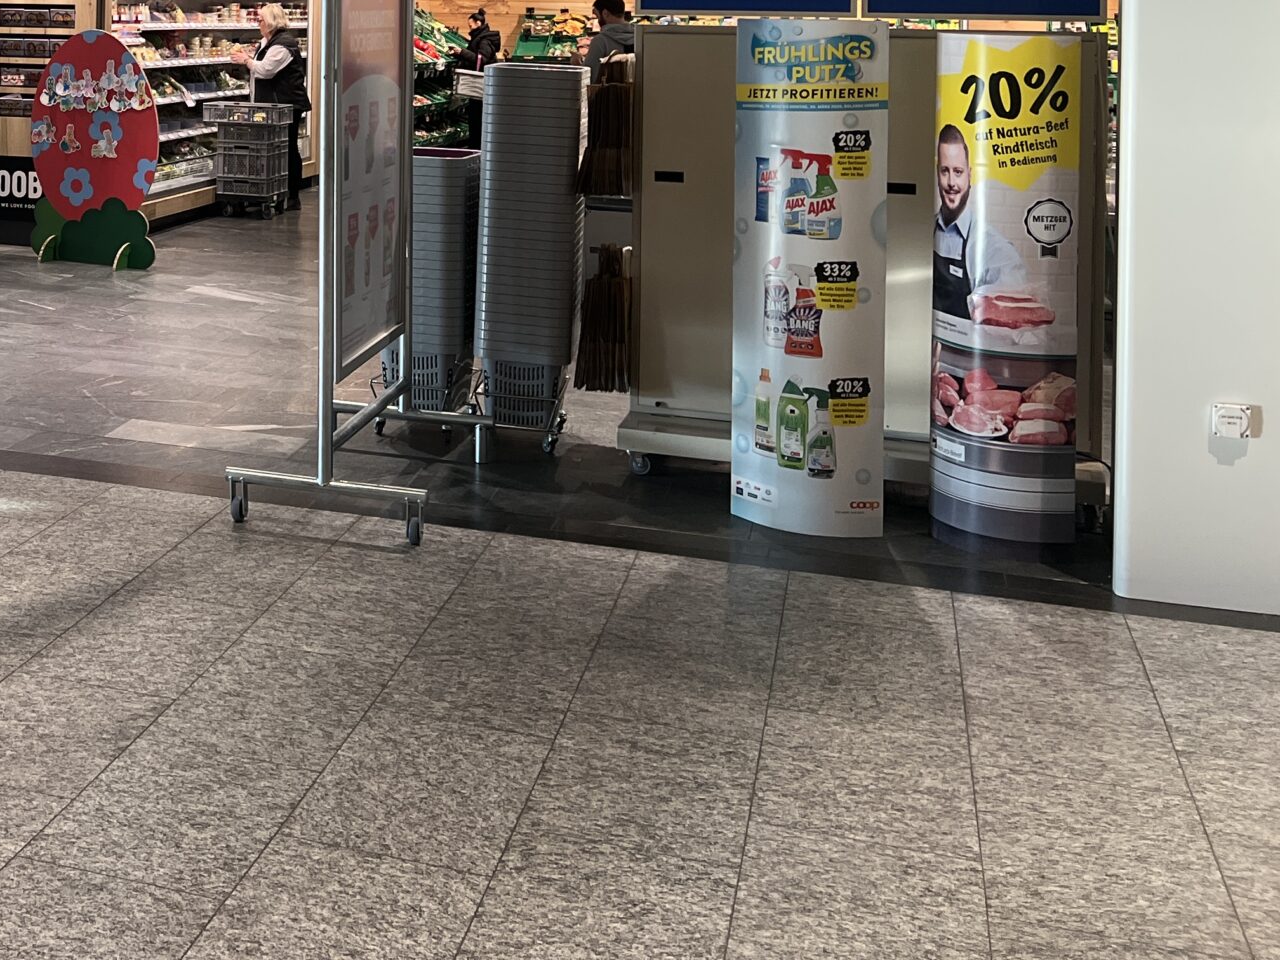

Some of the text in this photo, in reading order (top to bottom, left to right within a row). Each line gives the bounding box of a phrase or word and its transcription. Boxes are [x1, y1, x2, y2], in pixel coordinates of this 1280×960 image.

[754, 40, 871, 64] FRÜHLINGS
[747, 87, 879, 99] JETZT PROFITIEREN!
[960, 64, 1069, 125] 20%
[975, 117, 1070, 141] auf Natura-Beef
[838, 134, 866, 147] 20%
[992, 137, 1058, 156] Rindfleisch
[998, 153, 1058, 168] in Bedienung
[760, 170, 779, 183] AJAX
[785, 197, 806, 212] AJAX
[807, 197, 837, 217] AJAX
[1032, 215, 1068, 223] METZGER
[823, 263, 852, 277] 33%
[790, 319, 816, 331] BANG
[836, 380, 864, 393] 20%
[850, 501, 880, 511] coop
